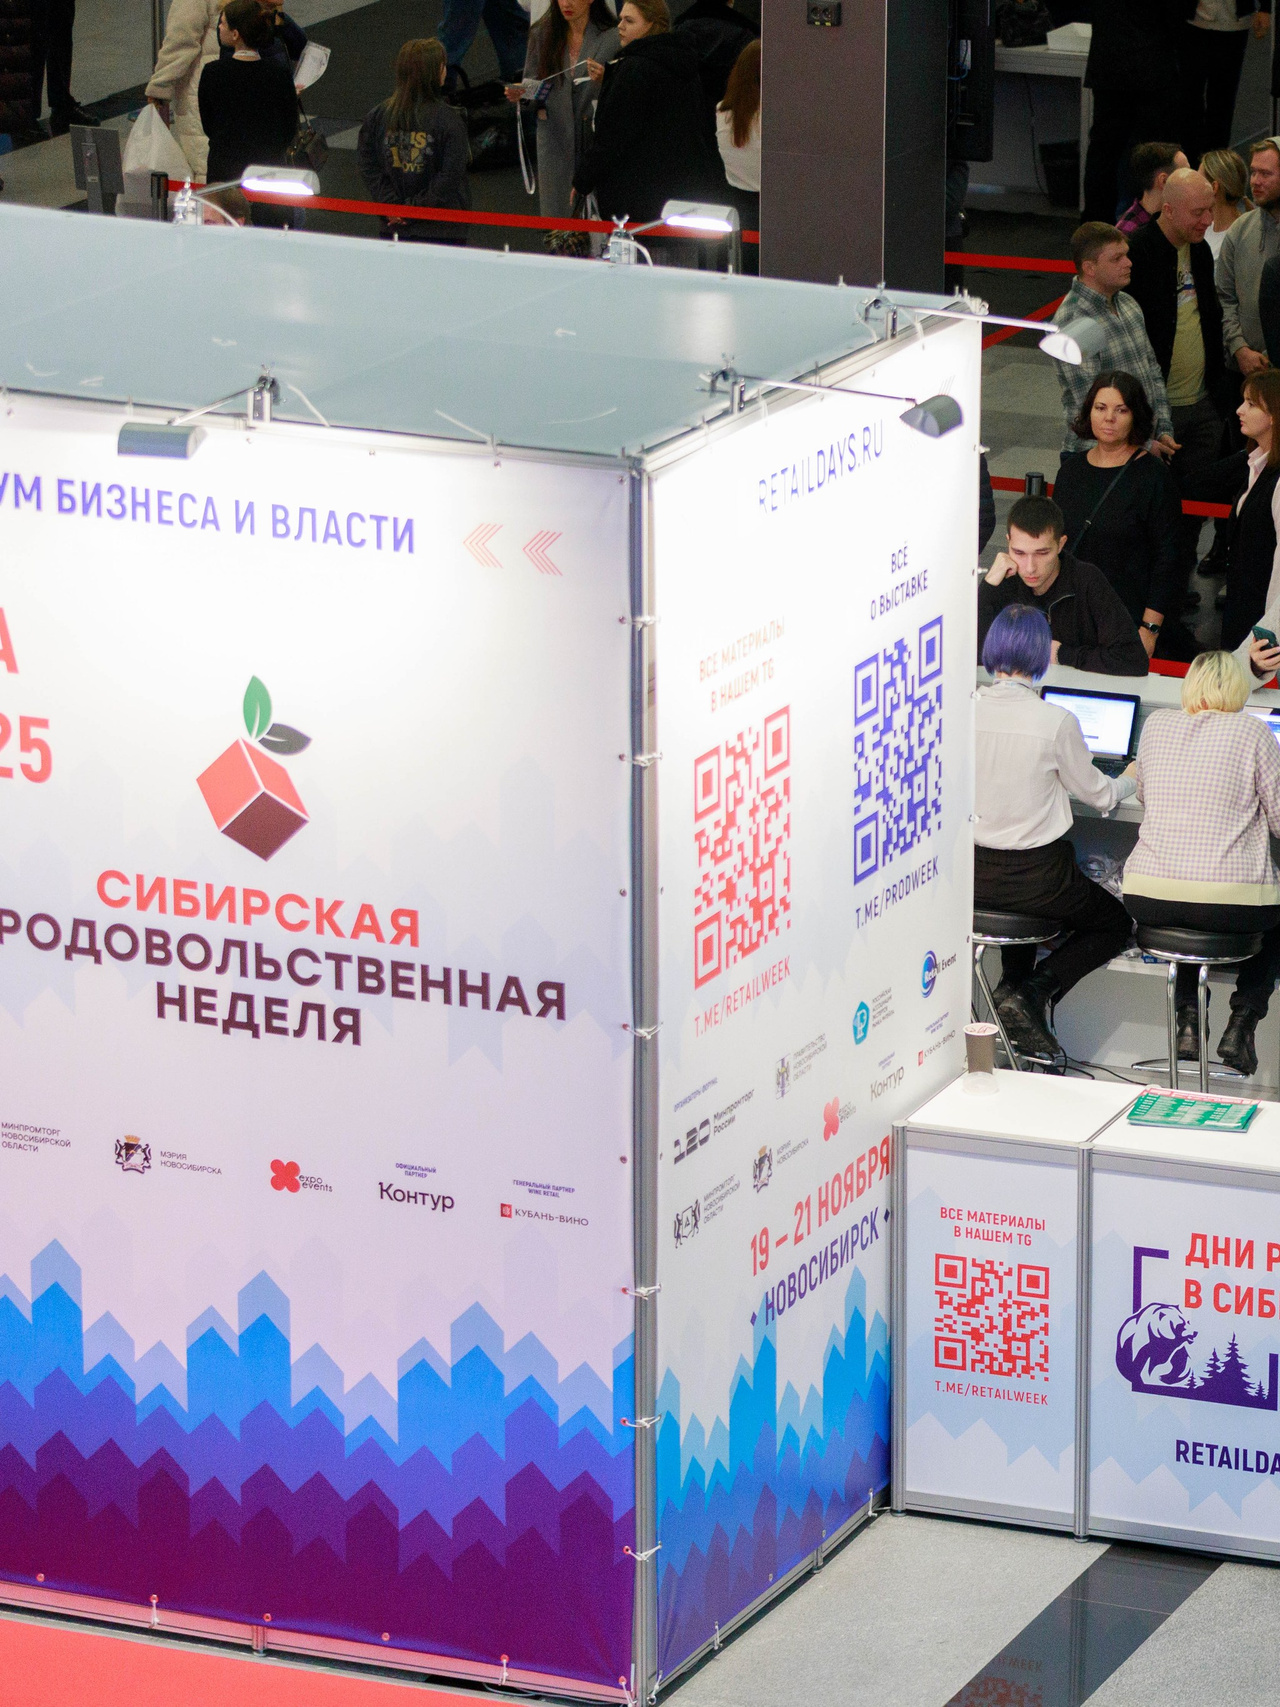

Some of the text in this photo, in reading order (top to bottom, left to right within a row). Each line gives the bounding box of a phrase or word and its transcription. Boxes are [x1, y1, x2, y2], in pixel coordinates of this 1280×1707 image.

[759, 419, 883, 514] RETAILDAYS.RU
[57, 478, 221, 532] БИЗНЕСА
[234, 499, 256, 536] И
[271, 504, 416, 555] ВЛАСТИ
[870, 569, 928, 621] О ВЫСТАВКЕ
[700, 615, 784, 683] ВСЕ МАТЕРИАЛЫ
[711, 657, 774, 713] В НАШЕМ TG
[96, 869, 420, 948] СИБИРСКАЯ
[856, 856, 939, 929] T.ME/PRODWEEK
[0, 908, 566, 1021] РОДОВОЛЬСТВЕННАЯ
[156, 982, 361, 1046] НЕДЕЛЯ
[695, 956, 791, 1038] T.ME/RETAILWEEK
[870, 1066, 905, 1102] Контур
[1, 1122, 61, 1136] МИНПРОМТОРГ
[1, 1131, 71, 1148] НОВОСИБИРСКОЙ
[1, 1140, 39, 1152] ОБЛАСТИ
[160, 1151, 187, 1161] МЭРИЯ
[160, 1160, 222, 1175] НОВОСИБИРСКА
[299, 1174, 323, 1187] expo
[302, 1181, 333, 1193] events
[378, 1181, 455, 1212] Контур
[515, 1208, 589, 1226] КУБАНЬ-ВИНО
[751, 1226, 770, 1277] 19
[794, 1194, 812, 1247] 21
[818, 1134, 891, 1228] НОЯБРЯ
[940, 1206, 1046, 1231] ВСЕ МАТЕРИАЛЫ
[953, 1225, 1032, 1246] В НАШЕМ TG
[1185, 1232, 1255, 1271] ДНИ
[765, 1206, 879, 1326] НОВОСИБИРСК
[1184, 1279, 1203, 1309] В
[935, 1380, 1049, 1405] T.ME/RETAILWEEK
